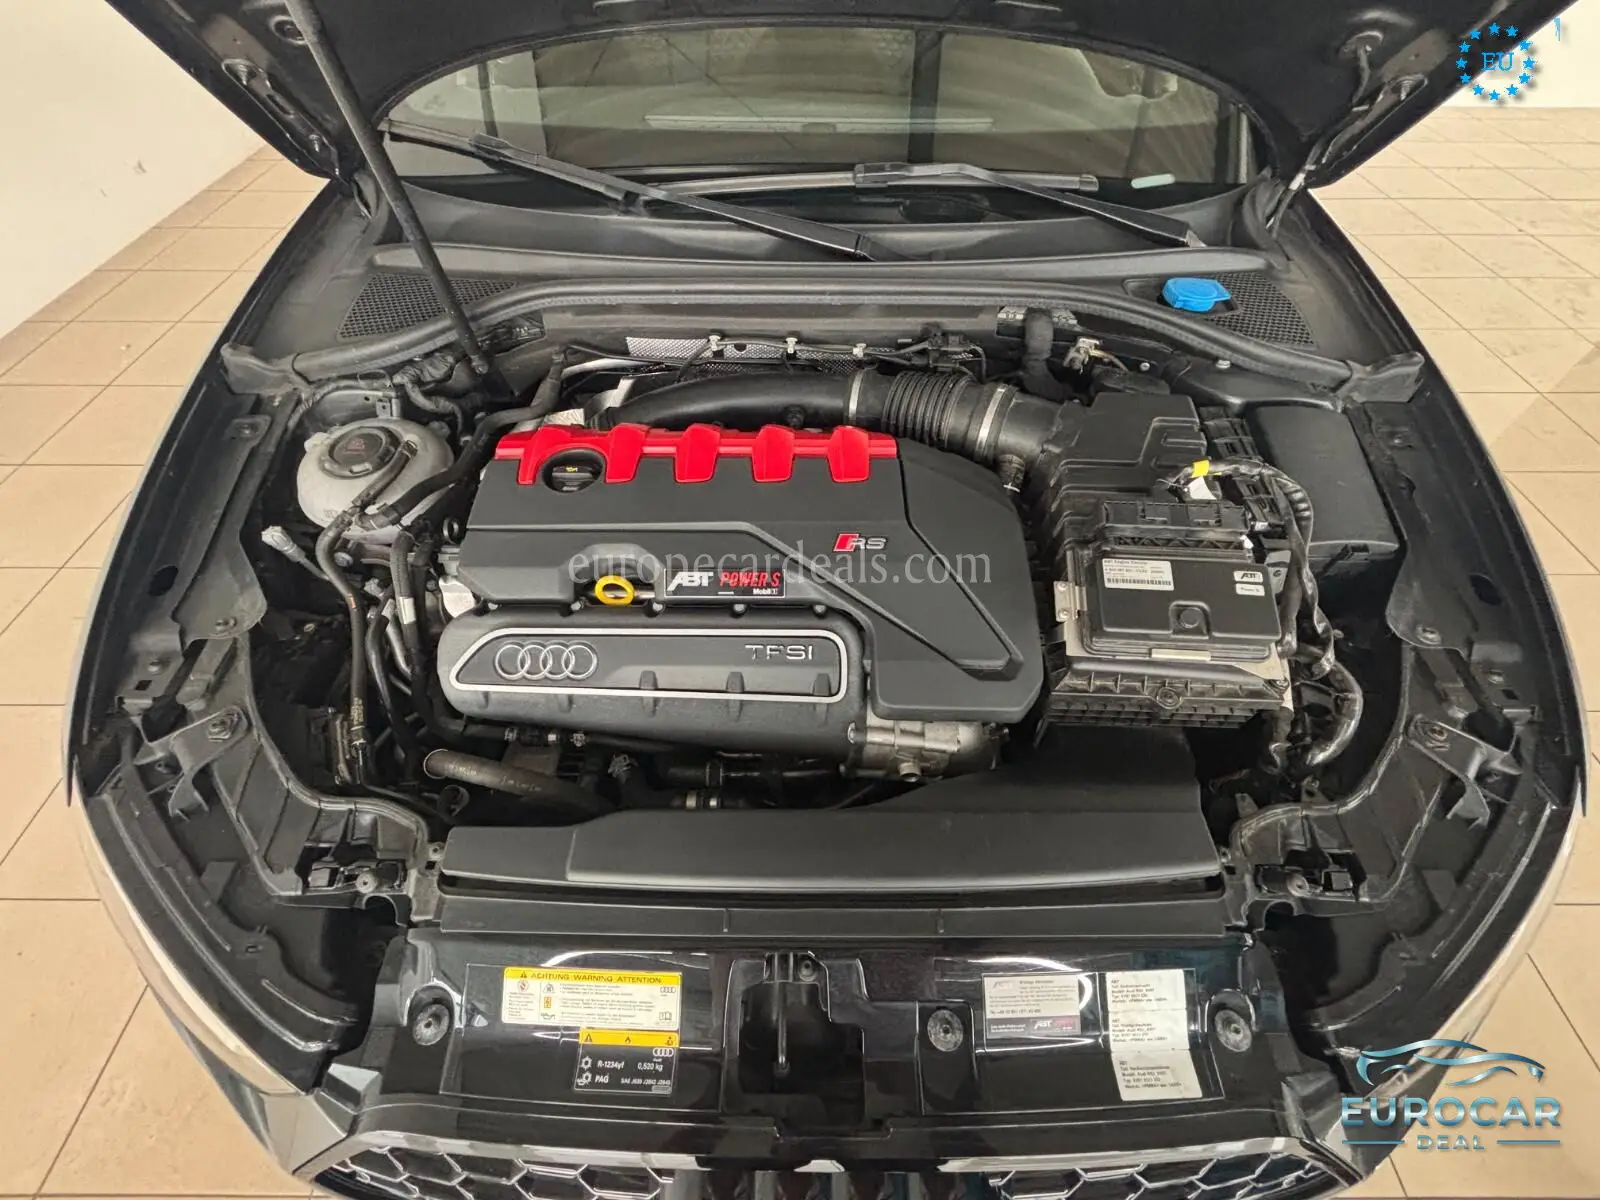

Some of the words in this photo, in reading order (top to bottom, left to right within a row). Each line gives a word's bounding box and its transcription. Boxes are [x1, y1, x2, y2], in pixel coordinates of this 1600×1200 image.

[833, 534, 886, 551] RS
[667, 572, 714, 591] ABT
[720, 570, 768, 587] POWER
[745, 644, 814, 660] TFSI
[531, 971, 570, 981] ACHTUNG
[573, 974, 613, 983] WARNING
[617, 976, 662, 984] ATTENTION
[598, 1060, 625, 1070] R-1234yf
